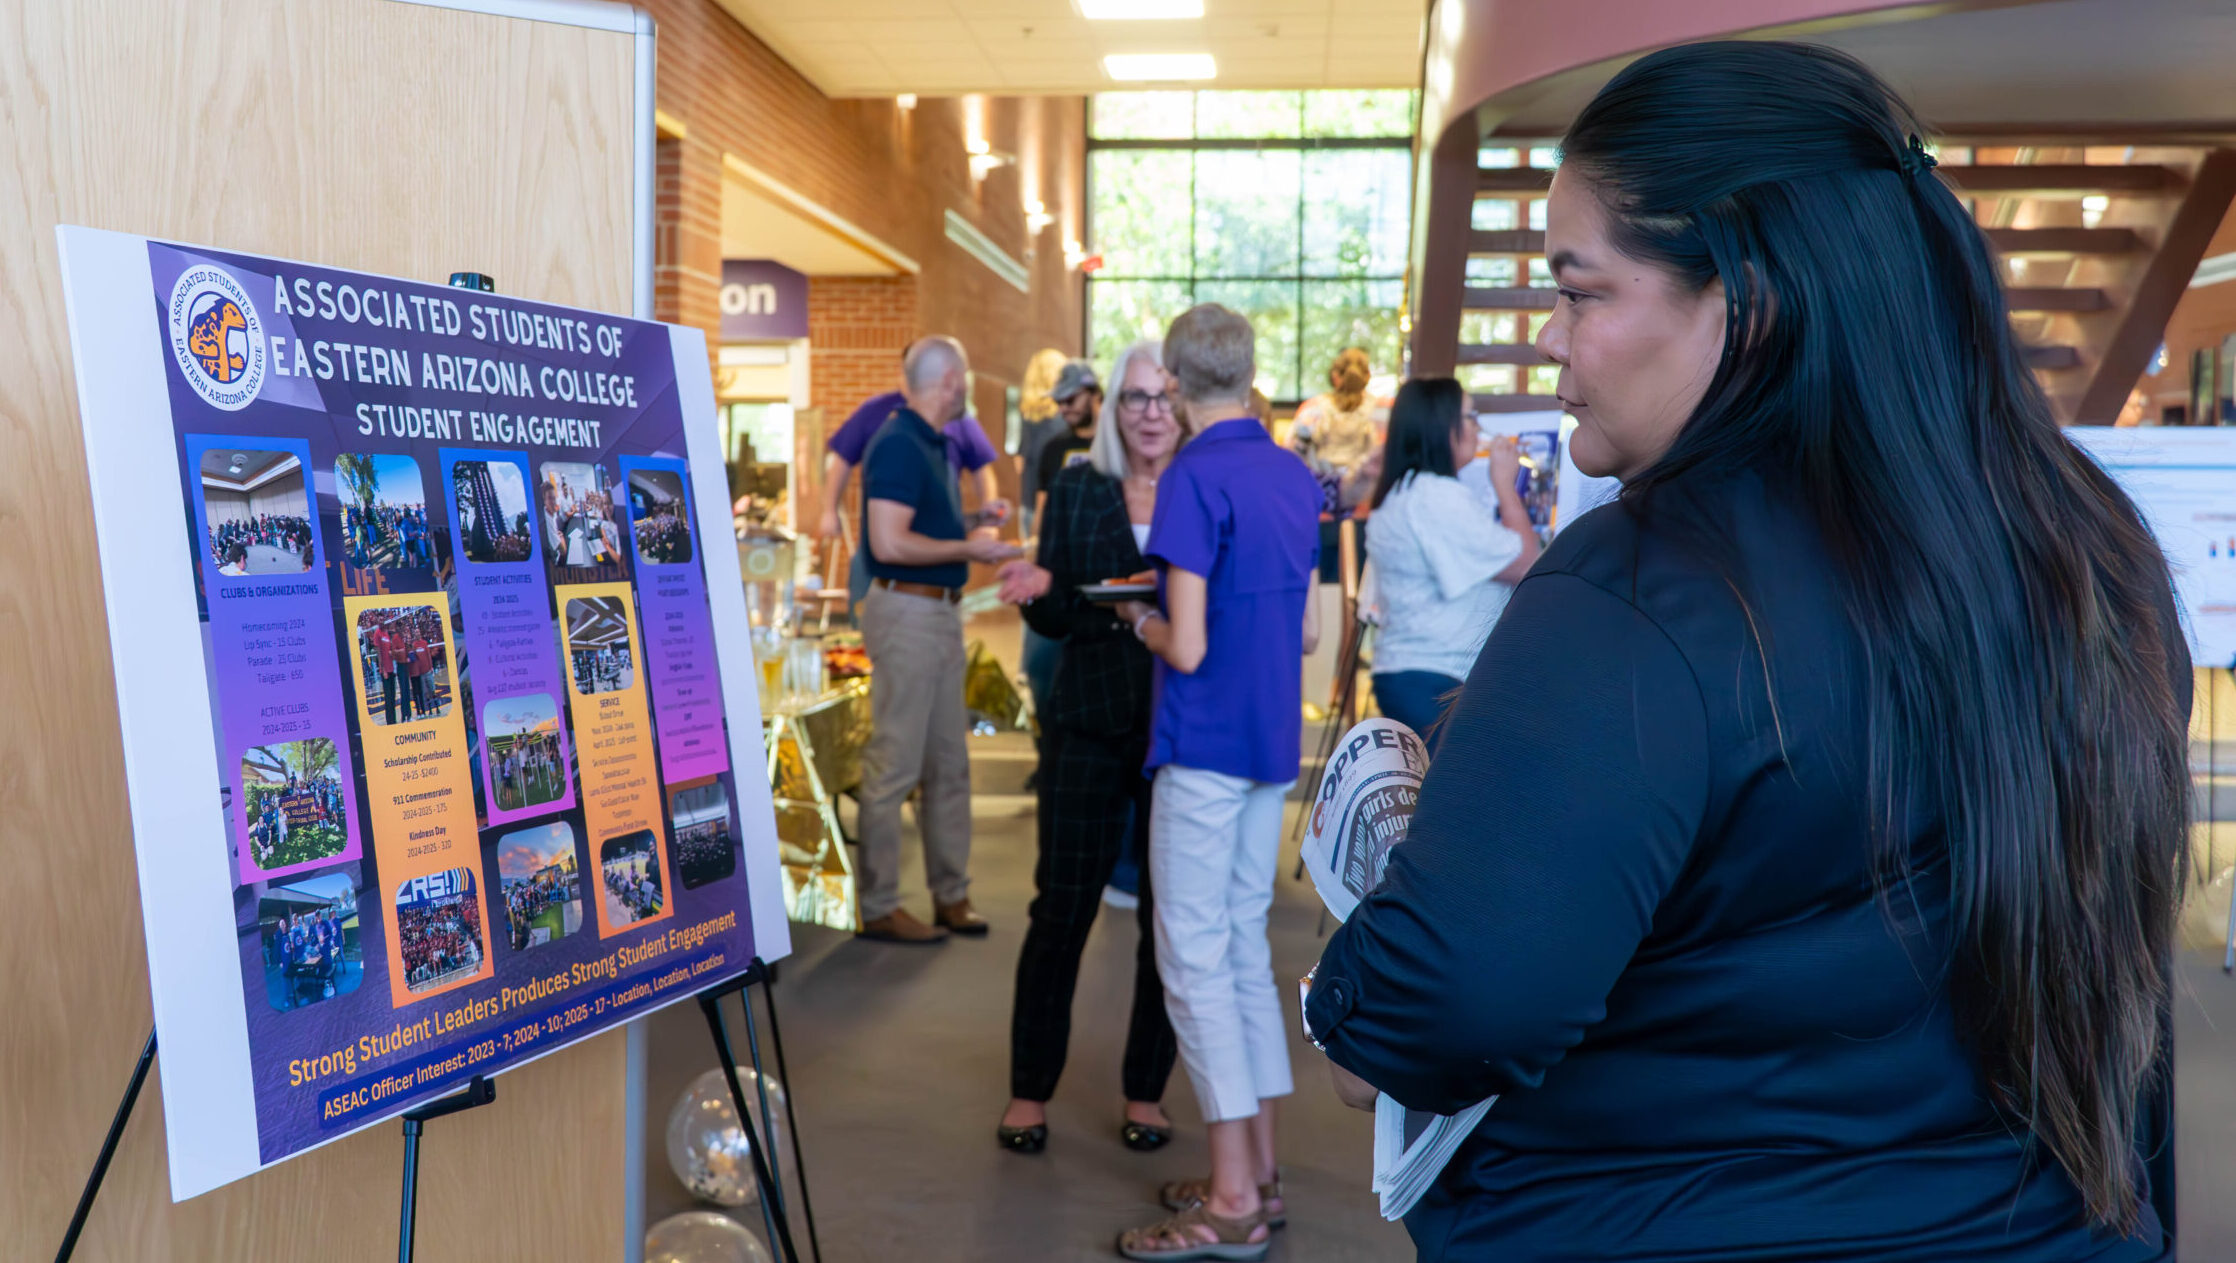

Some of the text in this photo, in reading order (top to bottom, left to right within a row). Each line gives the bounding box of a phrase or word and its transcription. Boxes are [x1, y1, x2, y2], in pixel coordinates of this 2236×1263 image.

[173, 271, 207, 327] ASSOCIATED
[208, 271, 251, 316] STUDENTS
[719, 282, 777, 316] on
[273, 274, 623, 359] ASSOCIATED STUDENTS OF
[176, 337, 263, 405] EASTERN ARIZONA COLLEGE
[271, 337, 638, 408] EASTERN ARIZONA COLLEGE
[356, 403, 601, 449] STUDENT ENGAGEMENT
[220, 584, 319, 599] CLUBS & ORGANIZATIONS
[242, 621, 288, 633] Homecoming
[260, 702, 310, 718] ACTIVE CLUBS
[394, 730, 437, 745] COMMUNITY
[384, 748, 452, 769] Scholarship Contributed
[405, 787, 453, 804] Commemoration
[1362, 790, 1395, 825] girls
[409, 826, 446, 841] Kindness Day
[288, 910, 737, 1087] Strong Student Leaders Produces Strong Student Engagement
[324, 1087, 370, 1120] ASEAC
[371, 1072, 415, 1101] Officer
[416, 1053, 466, 1084] Interest:
[467, 1039, 496, 1065] 2023
[502, 1033, 514, 1052] 7;
[513, 1023, 540, 1047] 2024
[547, 1015, 564, 1033] 10;
[564, 1005, 588, 1026] 2025
[595, 997, 606, 1015] 17
[612, 981, 653, 1008] Location,
[653, 967, 692, 992] Location,
[691, 952, 725, 976] Location
